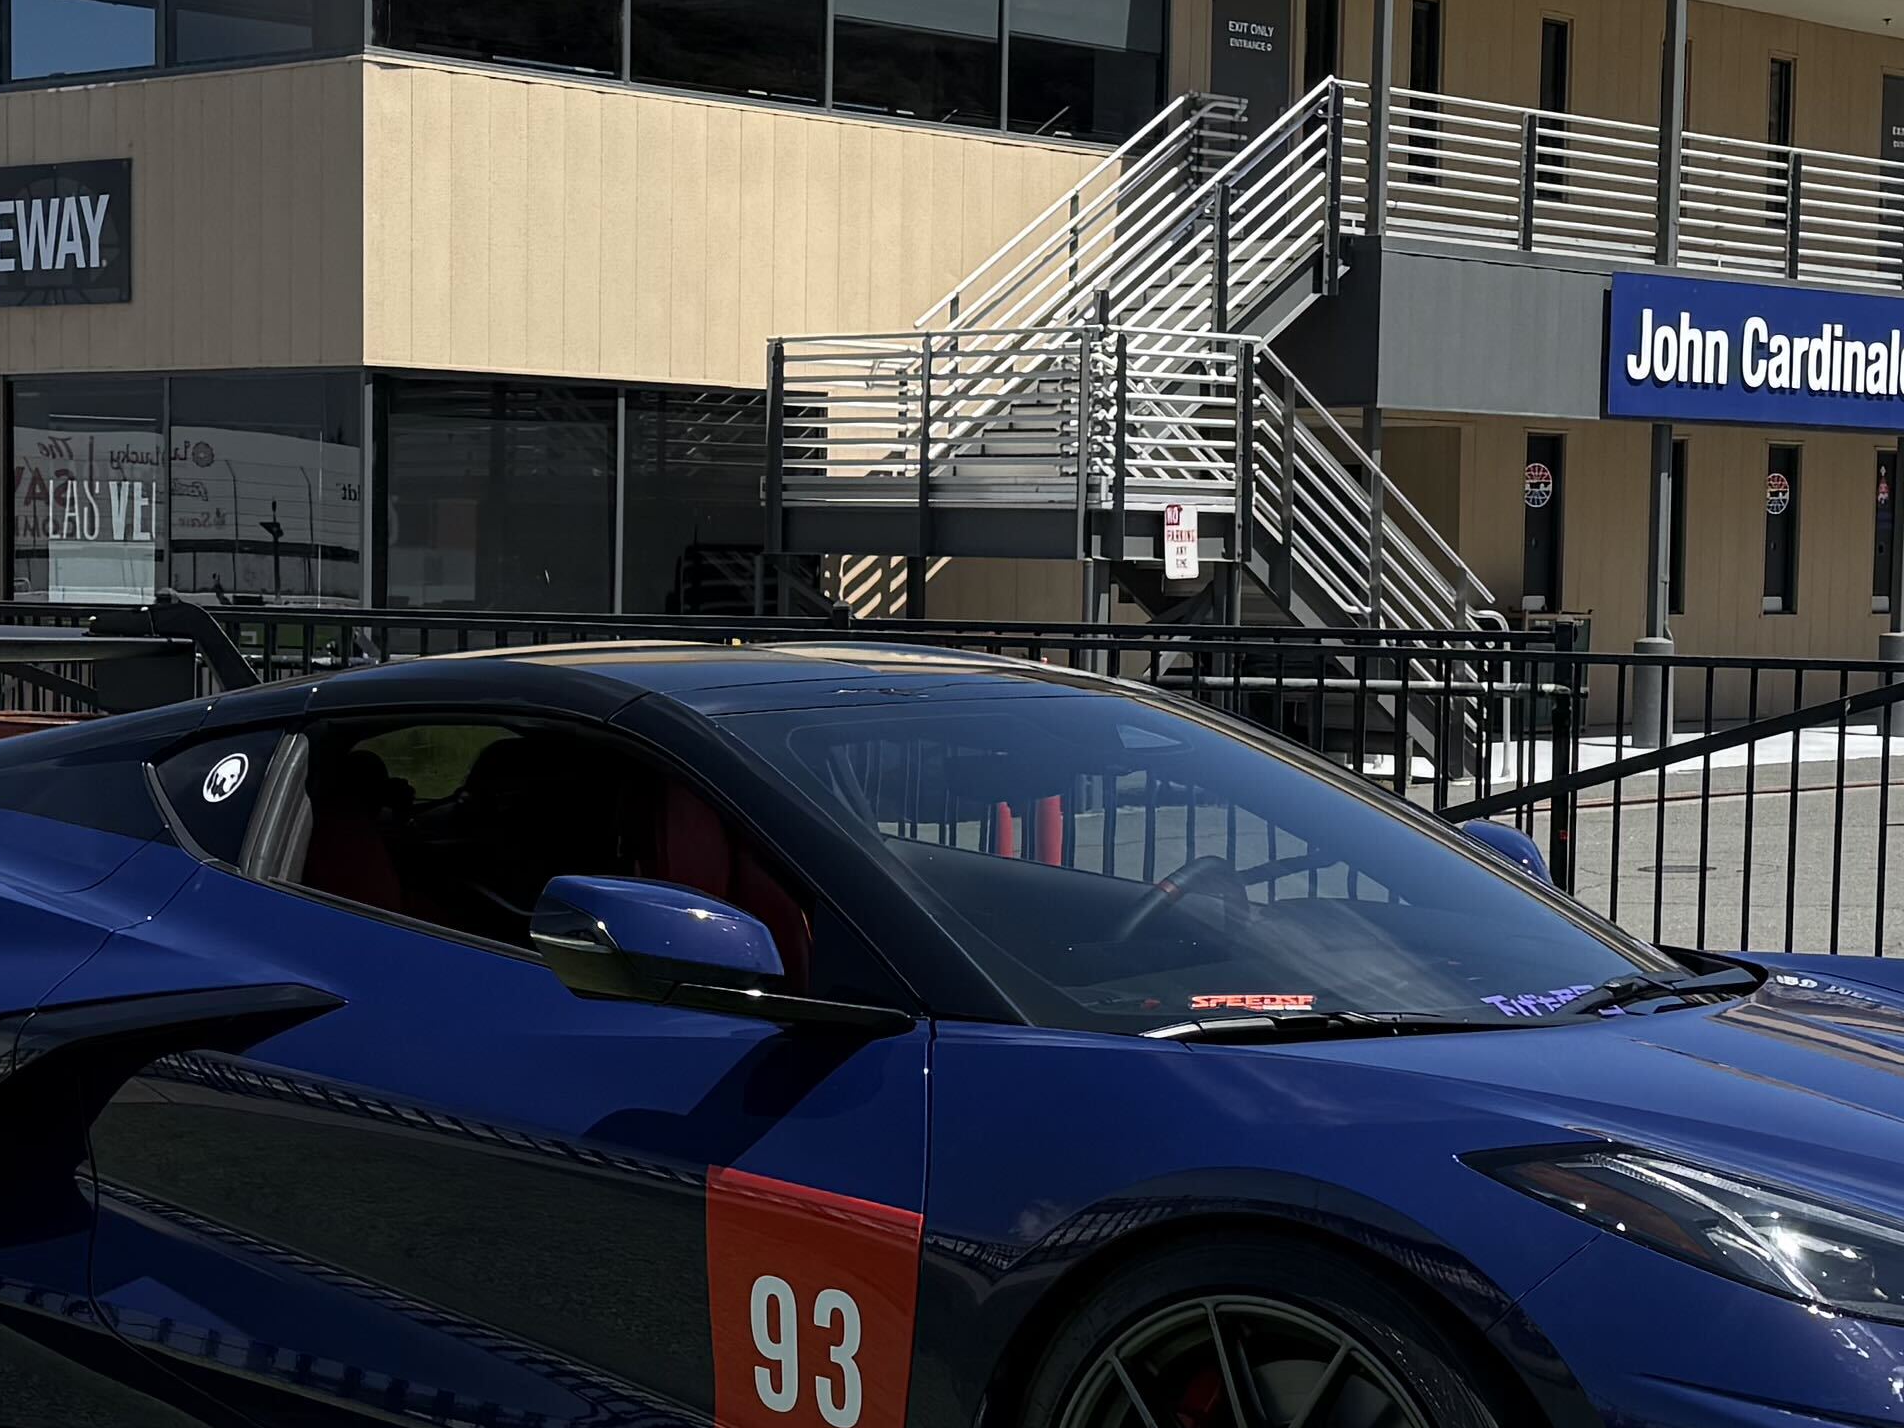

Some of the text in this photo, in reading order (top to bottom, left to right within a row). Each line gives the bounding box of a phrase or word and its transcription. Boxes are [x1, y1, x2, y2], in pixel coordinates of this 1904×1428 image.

[1229, 21, 1274, 37] EXIT ONLY
[1626, 308, 1728, 385] John
[750, 1275, 863, 1428] 93
